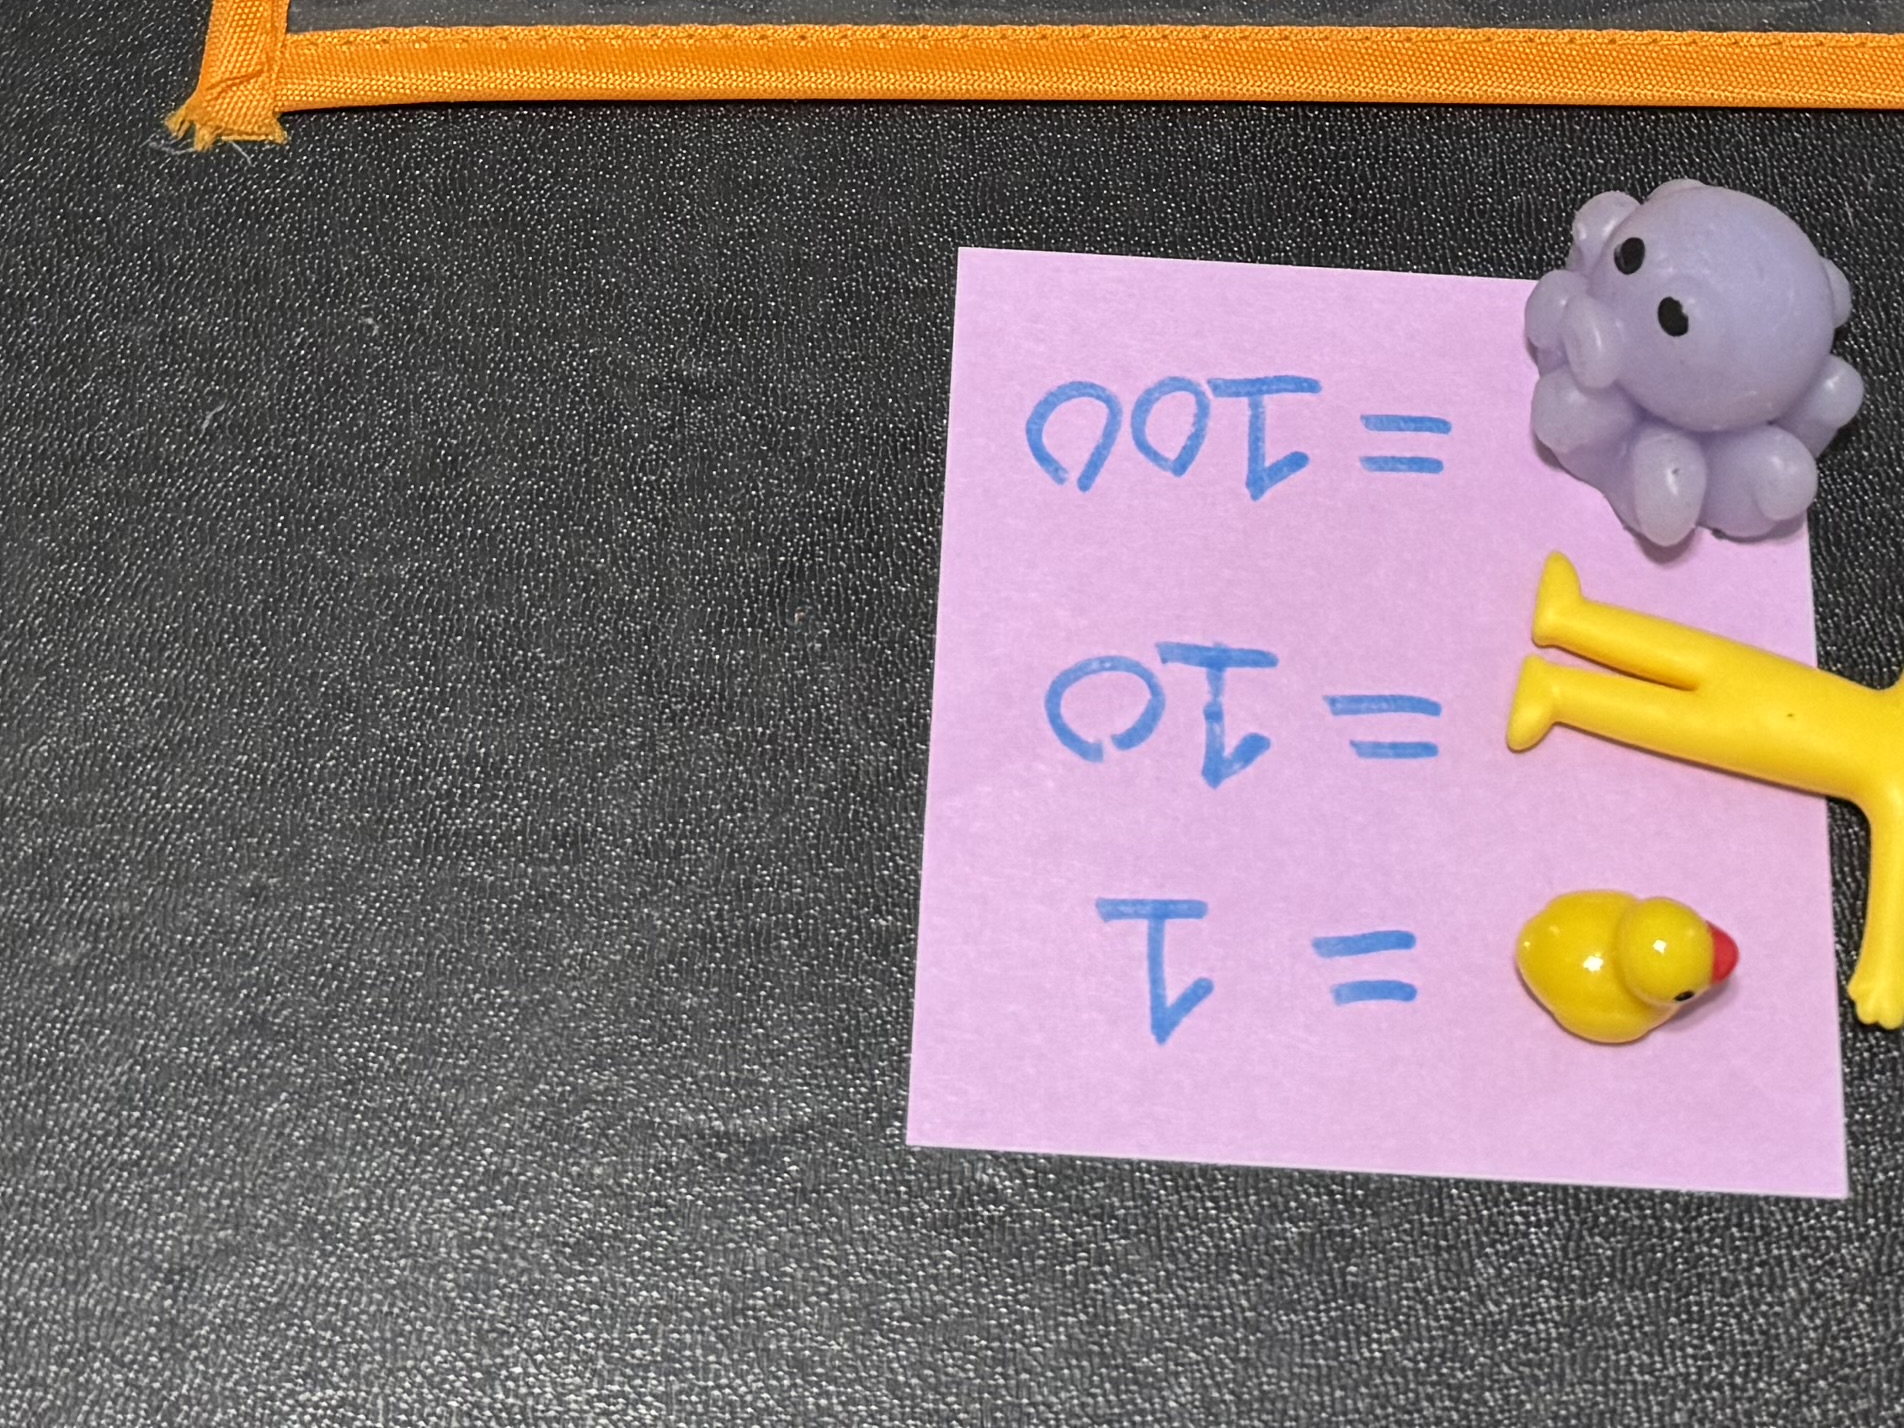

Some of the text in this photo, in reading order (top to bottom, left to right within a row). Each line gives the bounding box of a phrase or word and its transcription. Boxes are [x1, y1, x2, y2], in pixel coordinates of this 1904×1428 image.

[1026, 376, 1322, 500] 100
[1045, 643, 1279, 789] 10
[1097, 900, 1213, 1044] 1
